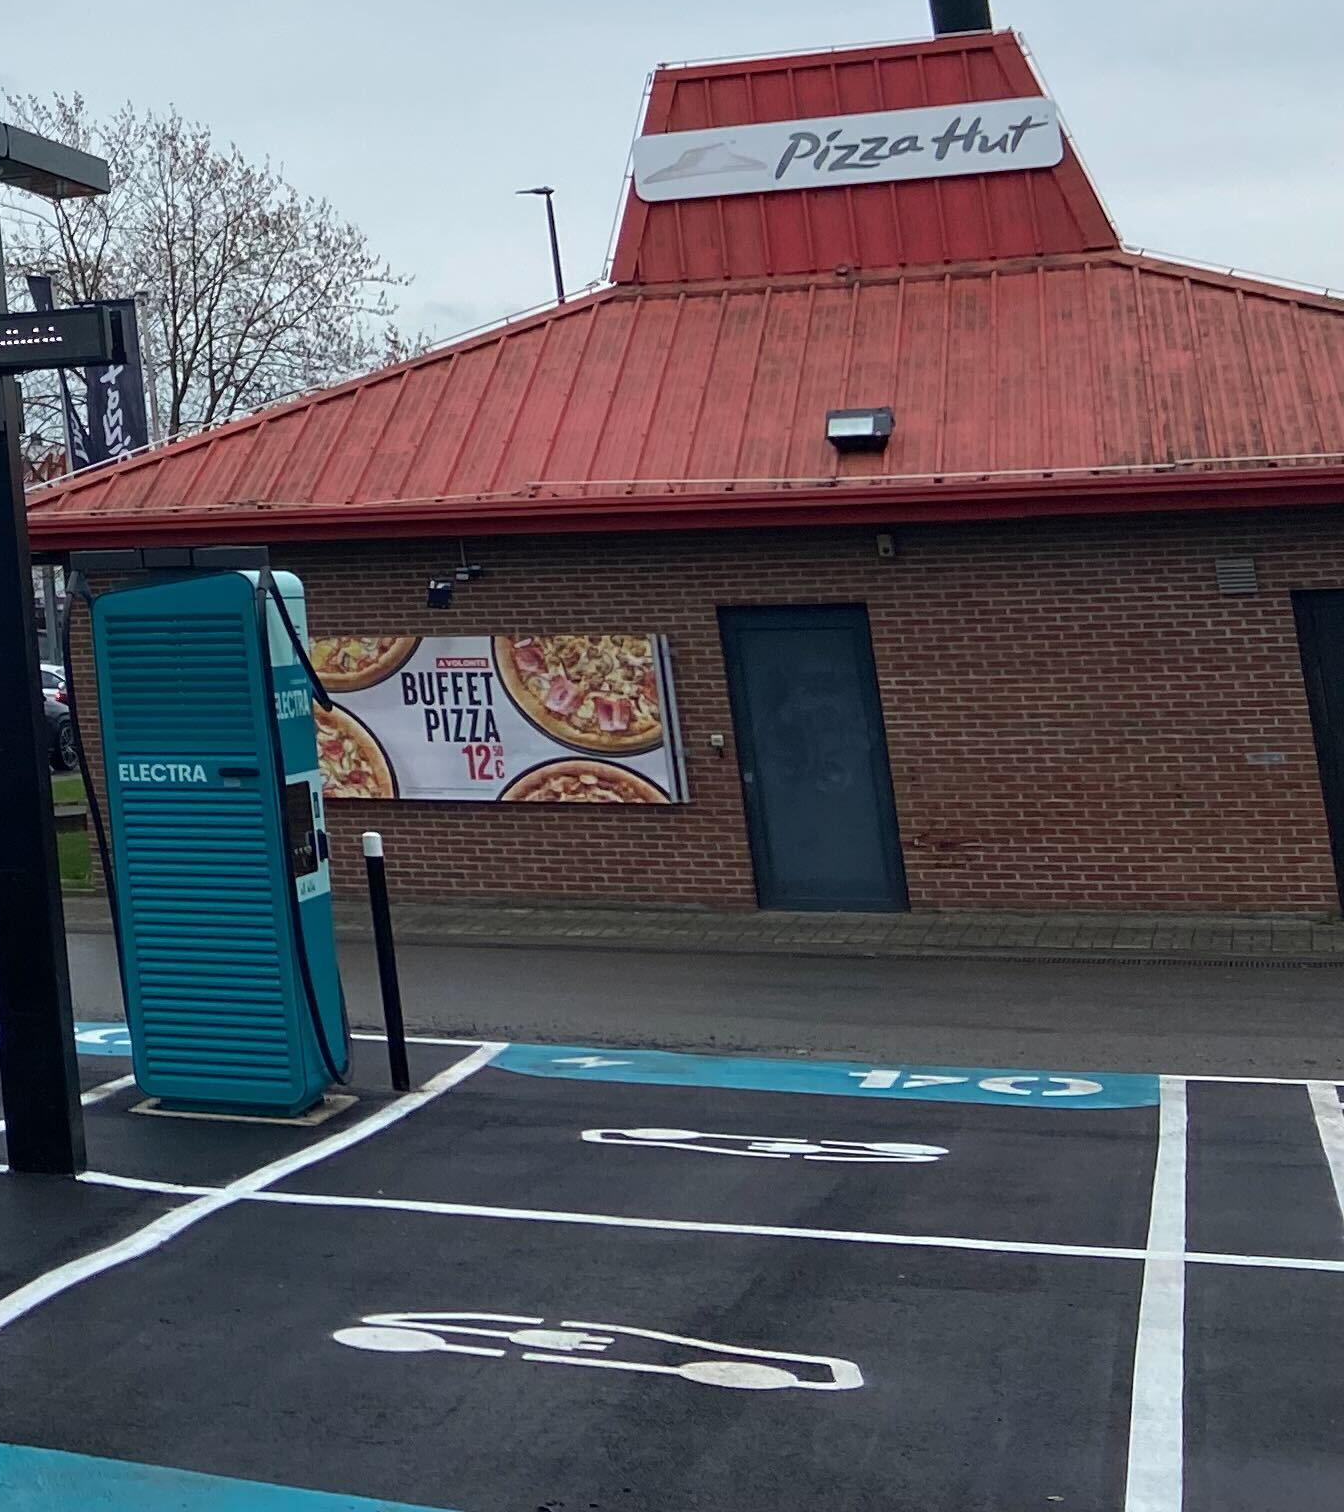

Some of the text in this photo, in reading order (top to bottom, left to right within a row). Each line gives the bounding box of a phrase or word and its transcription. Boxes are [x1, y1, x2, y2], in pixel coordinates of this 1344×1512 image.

[775, 115, 1049, 180] Pizza Hut
[401, 672, 493, 706] BUFFET
[424, 709, 501, 743] PIZZA
[118, 763, 207, 783] ELECTRA
[463, 744, 493, 780] 12
